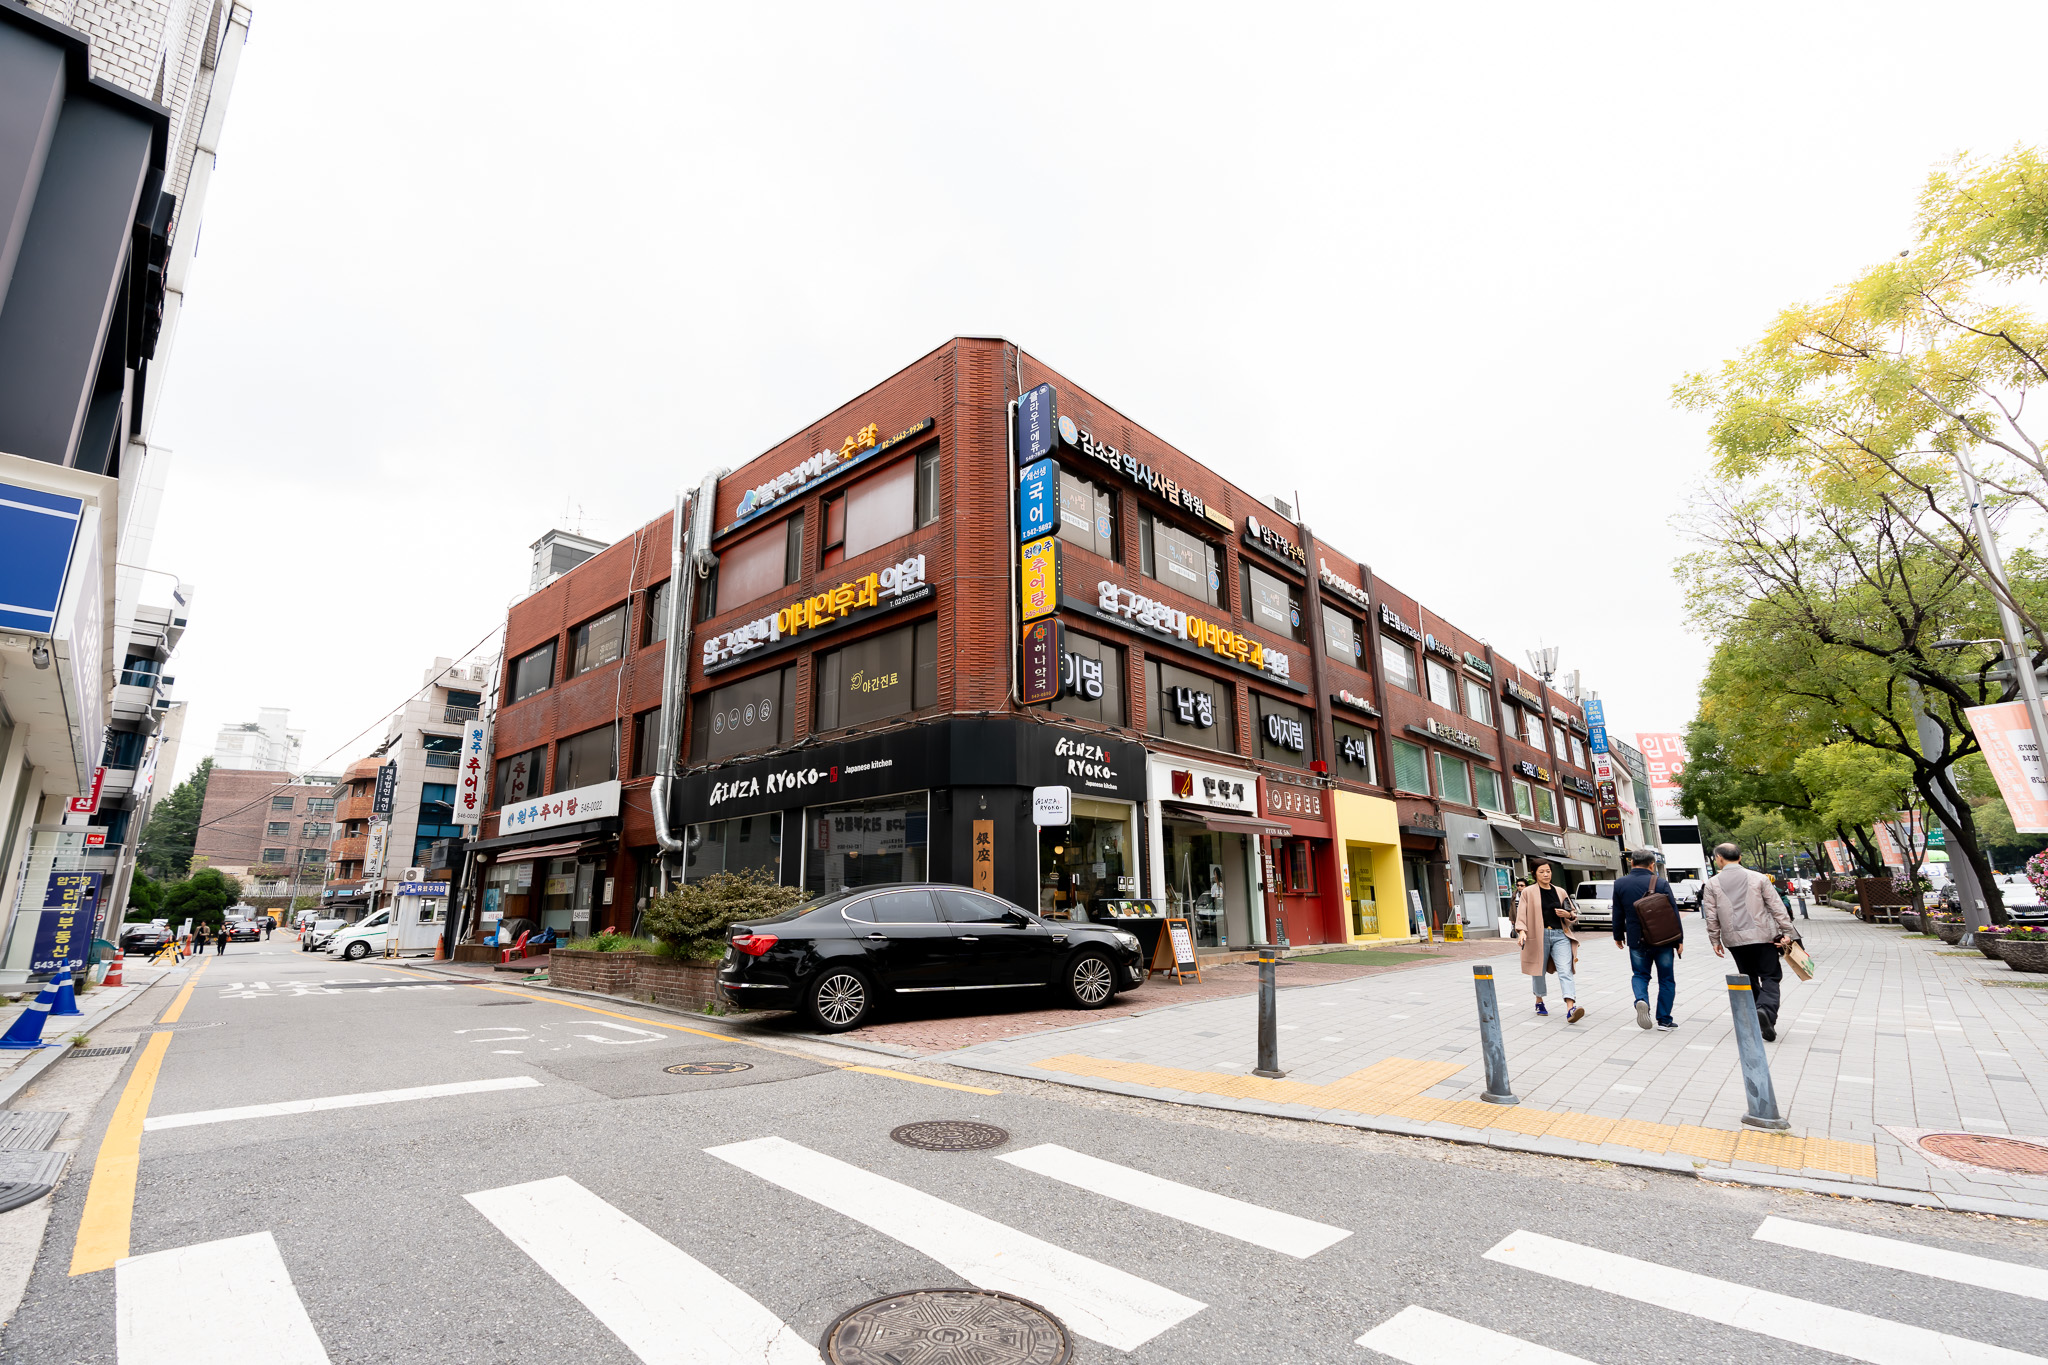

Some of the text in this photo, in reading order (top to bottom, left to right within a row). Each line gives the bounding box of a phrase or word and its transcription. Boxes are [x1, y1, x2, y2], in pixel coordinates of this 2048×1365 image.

[838, 422, 879, 460] 수학
[1080, 430, 1121, 470] 김소강
[1182, 486, 1205, 519] 학원
[1028, 481, 1044, 522] 국어
[1029, 558, 1047, 607] 추어탕
[1025, 603, 1054, 619] 546-0022
[1034, 642, 1047, 690] 하나약국
[1065, 654, 1103, 699] 이명
[862, 672, 899, 693] 야간진료
[1176, 687, 1214, 728] 난청
[470, 729, 483, 754] 원주
[1268, 714, 1304, 751] 어지럼
[1642, 736, 1684, 758] 임대
[1055, 737, 1105, 762] GINZA
[1344, 736, 1367, 766] 수액
[844, 758, 893, 775] Japanese kitchen
[463, 757, 481, 810] 추어탕
[709, 777, 760, 807] GINZA
[1084, 780, 1118, 790] Japanese kitchen
[457, 812, 479, 820] 546-0022
[516, 797, 579, 825] 원주 추어탕
[580, 800, 603, 814] 546-0022
[1035, 798, 1057, 806] GINZA
